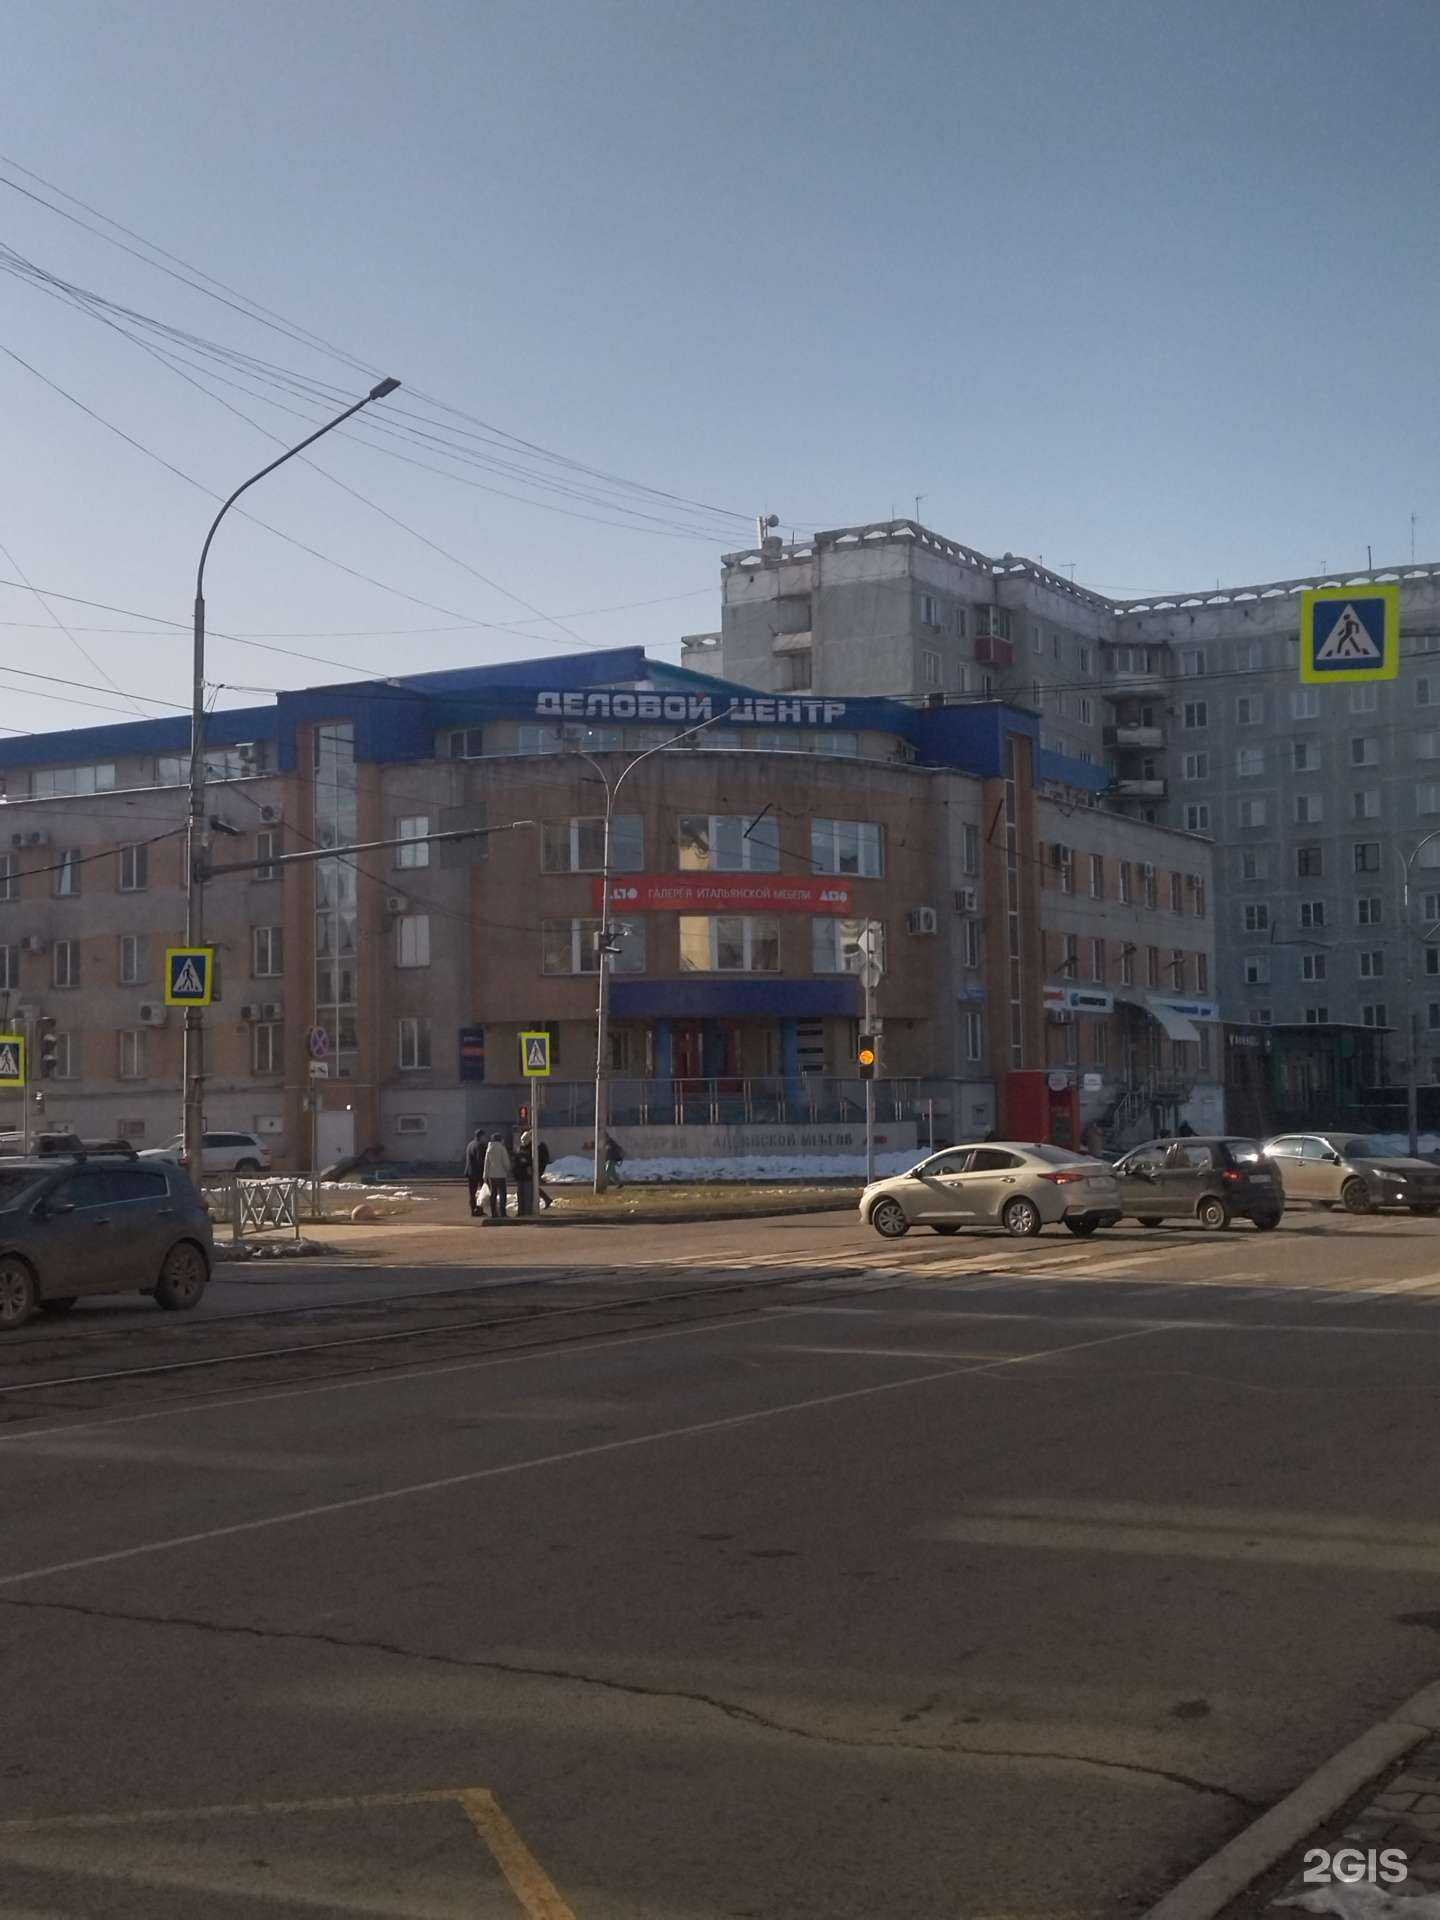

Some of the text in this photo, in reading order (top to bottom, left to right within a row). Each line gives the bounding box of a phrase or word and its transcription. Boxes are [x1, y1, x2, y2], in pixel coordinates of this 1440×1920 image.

[535, 690, 846, 723] ДЕЛОВОЙ ЦЕНТР
[648, 887, 692, 898] ГАЛЕРЕЯ
[697, 887, 770, 899] ИТАЛЬЯНСКОЙ
[774, 888, 811, 900] МЕБЕЛИ
